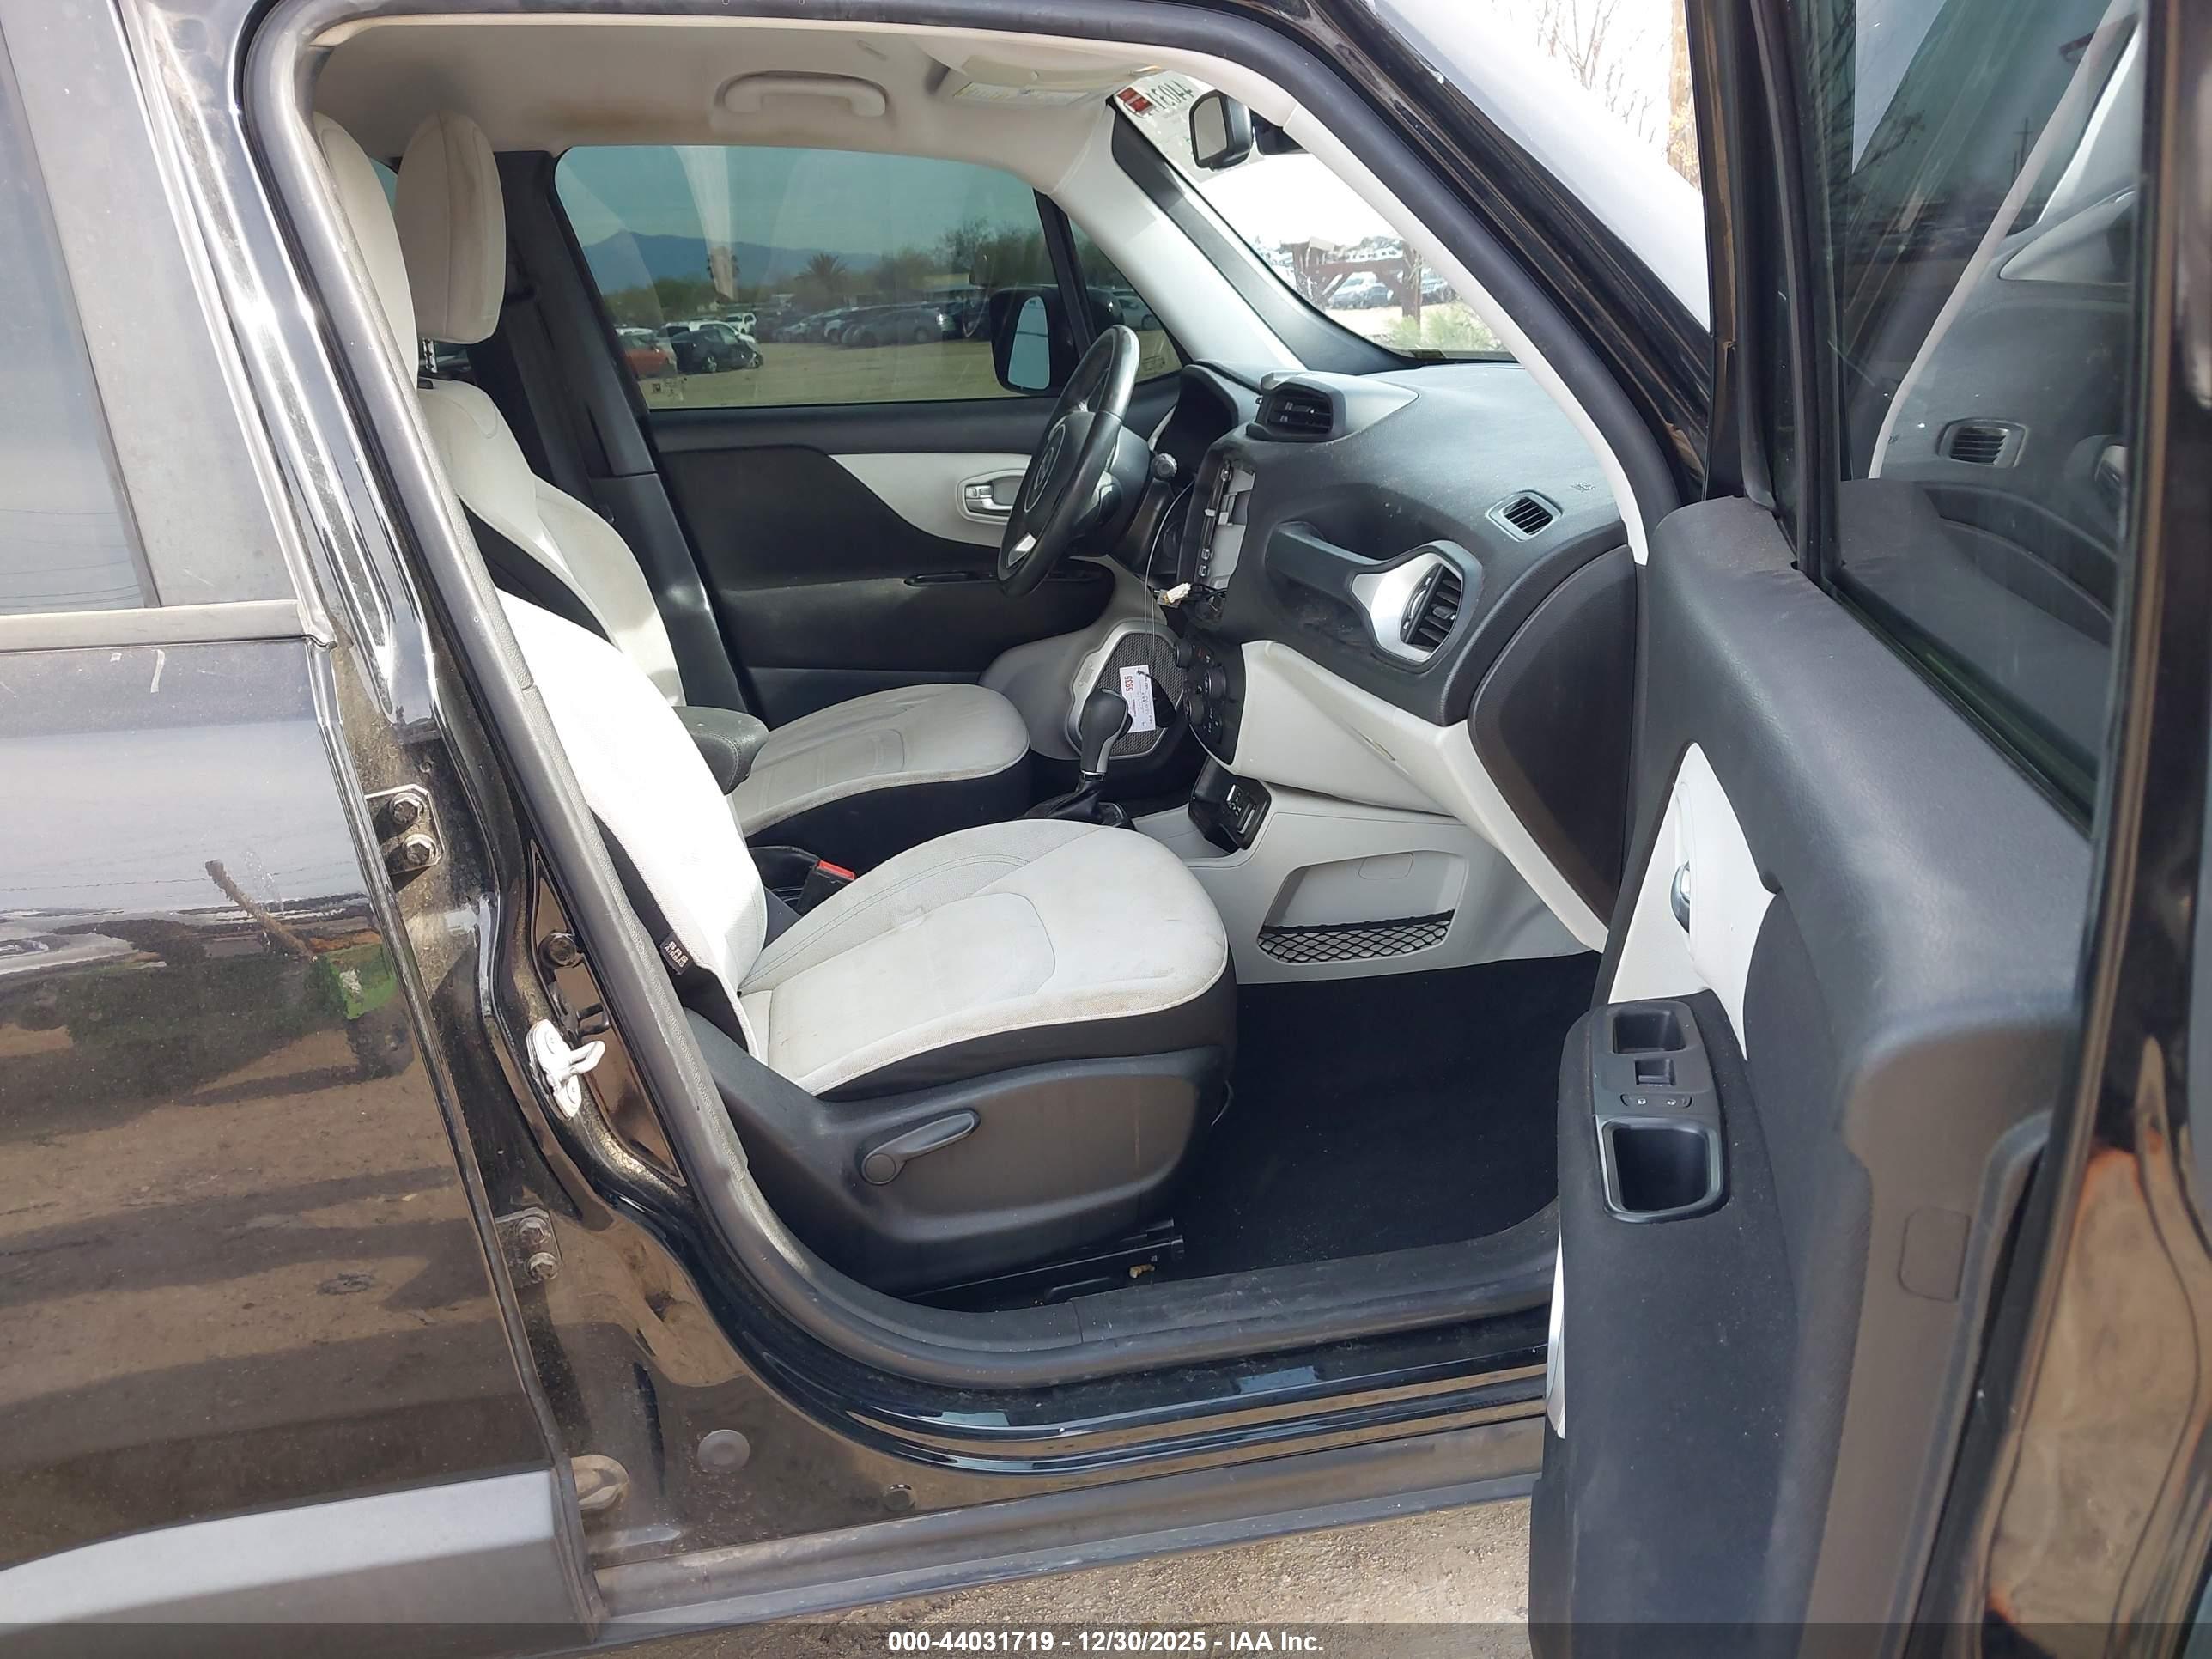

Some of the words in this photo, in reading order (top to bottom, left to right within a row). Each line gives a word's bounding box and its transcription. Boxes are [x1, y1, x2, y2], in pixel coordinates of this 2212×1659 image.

[1124, 675, 1134, 692] 5935
[664, 946, 685, 968] AIRBAG
[669, 941, 689, 963] SRS
